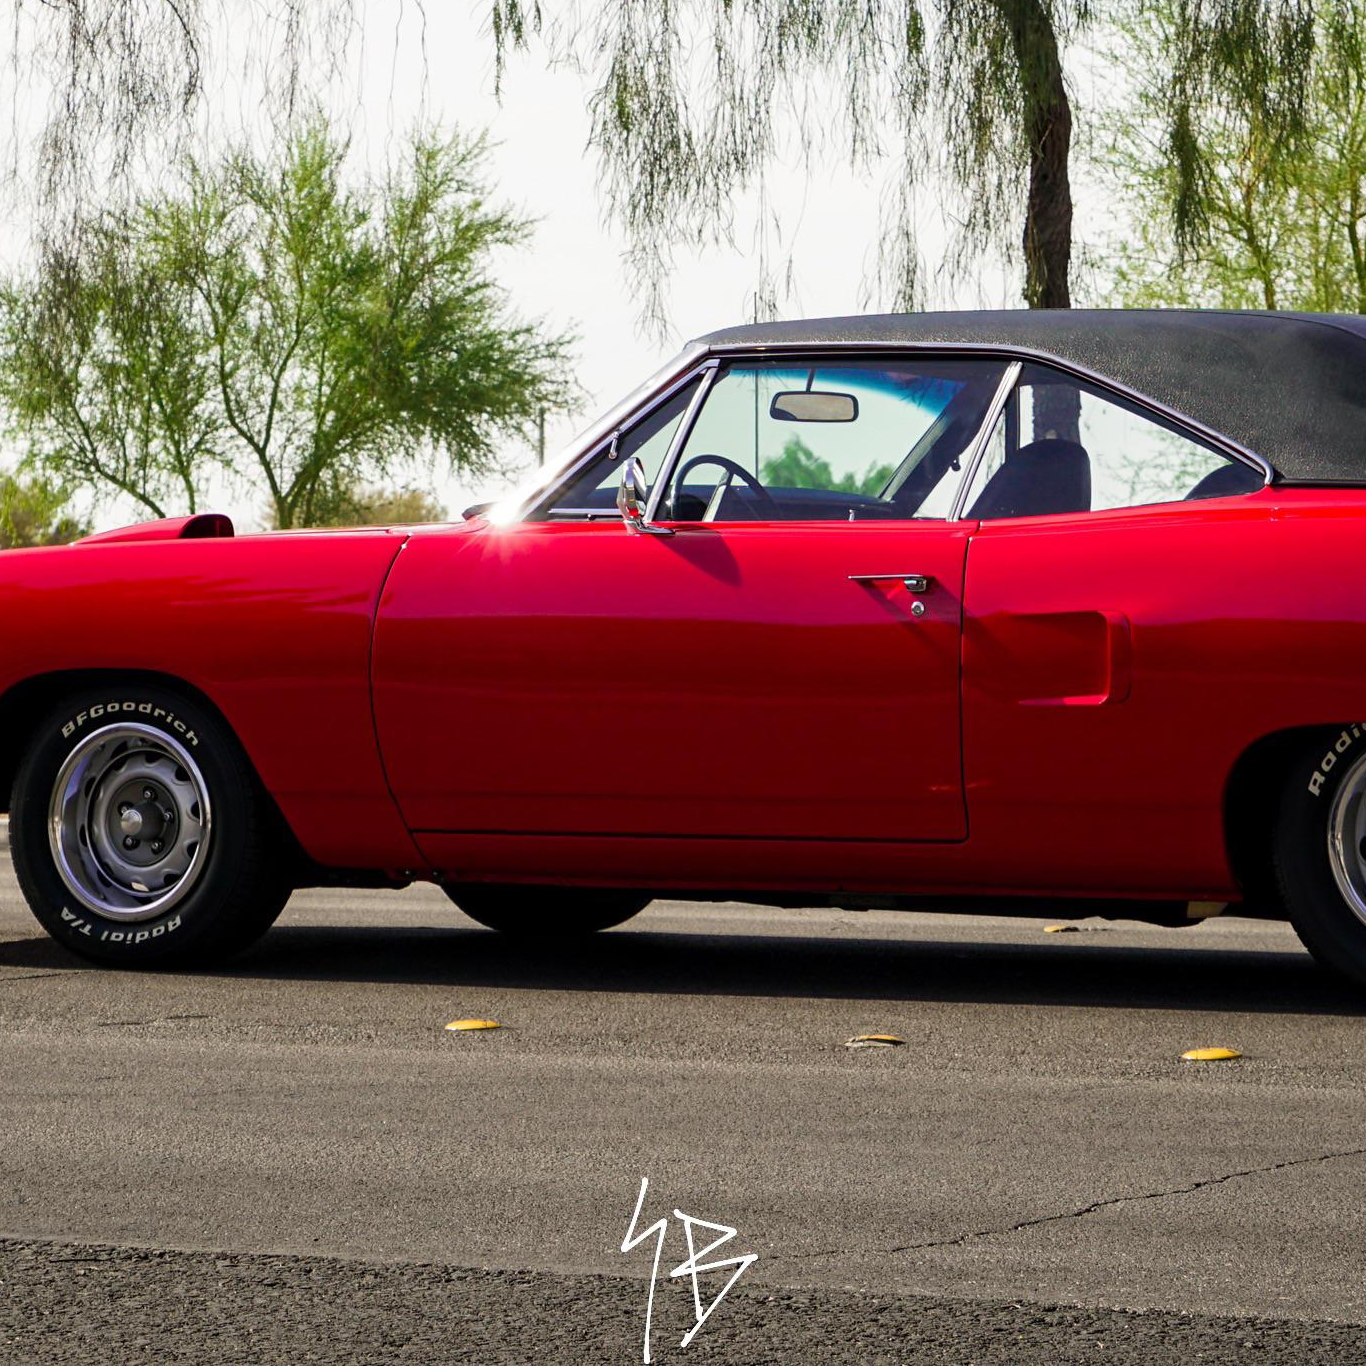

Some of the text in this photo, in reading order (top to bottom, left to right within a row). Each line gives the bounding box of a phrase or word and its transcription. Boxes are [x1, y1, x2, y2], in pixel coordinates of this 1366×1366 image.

[61, 701, 199, 747] BFGoodrich
[60, 906, 183, 944] Radial T/A
